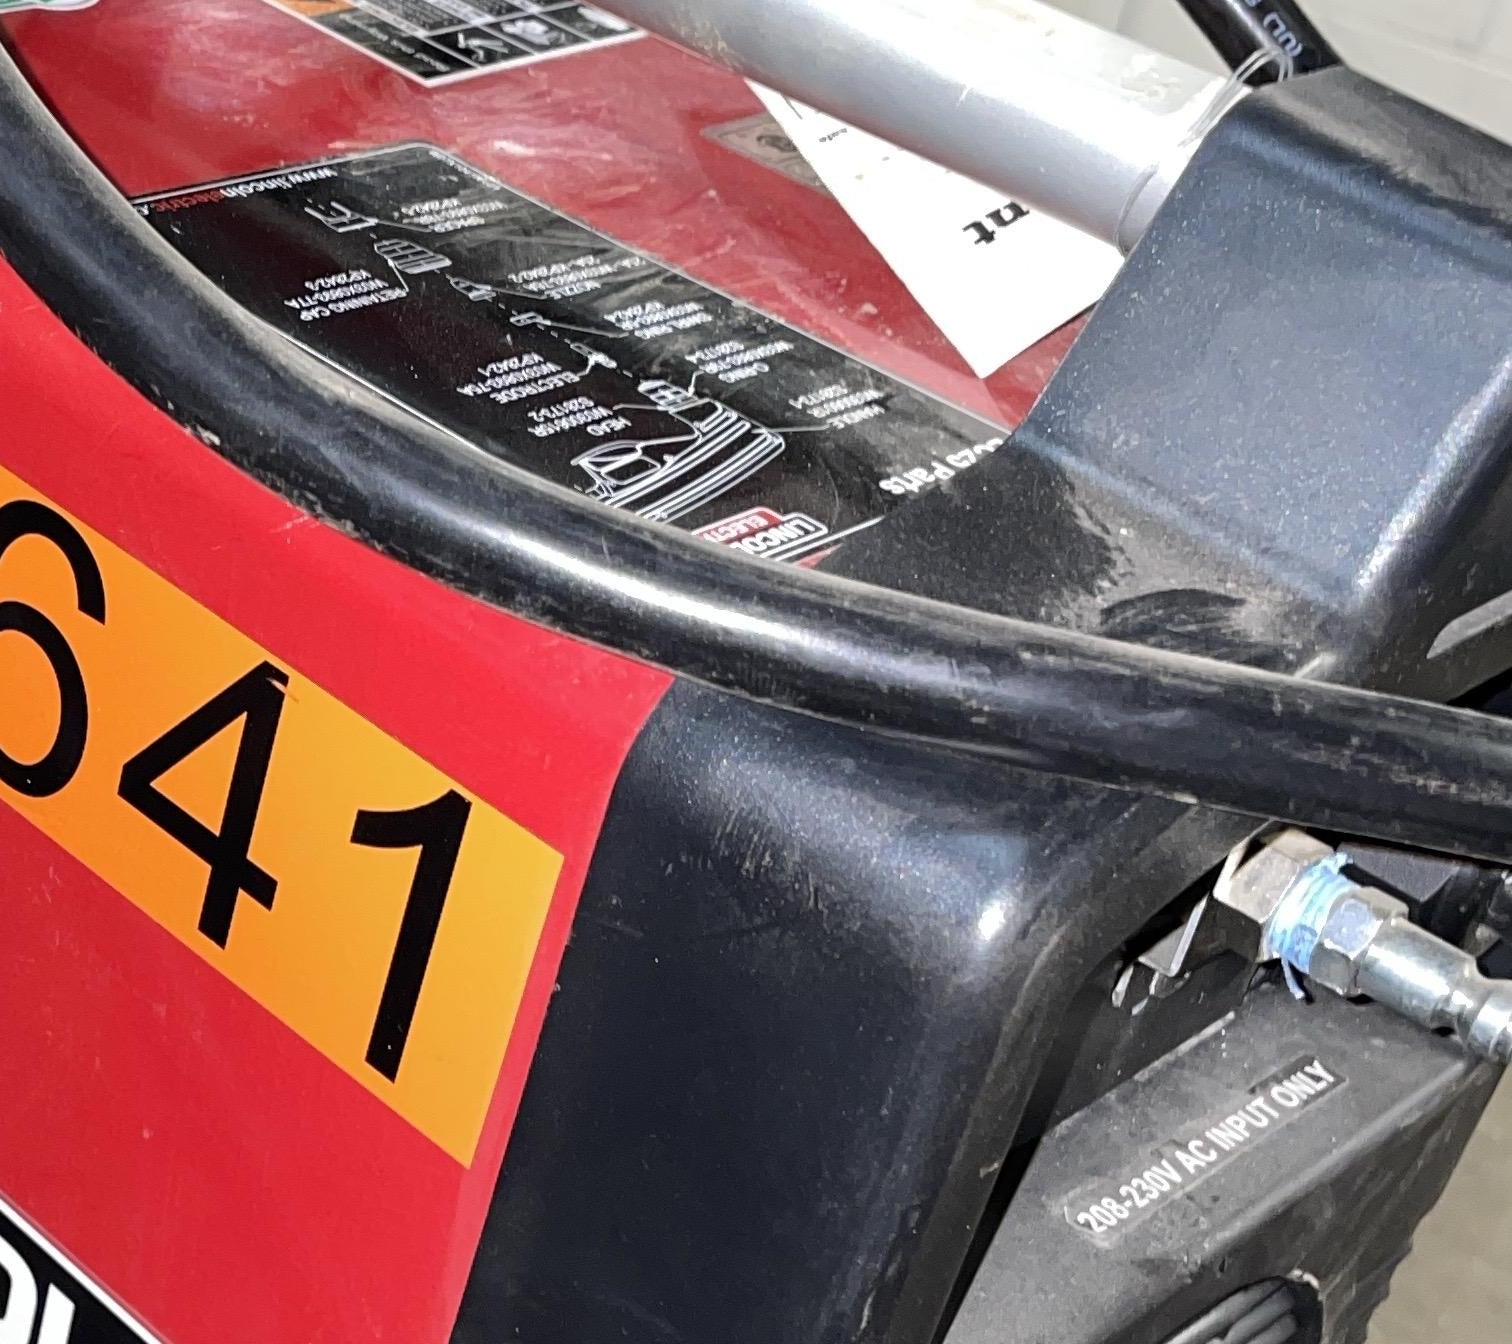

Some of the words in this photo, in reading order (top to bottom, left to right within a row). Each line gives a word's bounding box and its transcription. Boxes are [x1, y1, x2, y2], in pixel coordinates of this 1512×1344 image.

[489, 372, 579, 401] ELECTRODE
[585, 417, 630, 434] HEAD
[878, 459, 956, 495] Parts
[728, 517, 816, 555] LINCOL
[1076, 1160, 1178, 1234] 208-230V
[1174, 1136, 1219, 1175] AC
[1213, 1096, 1283, 1154] INPUT
[1268, 1059, 1338, 1108] ONLY
